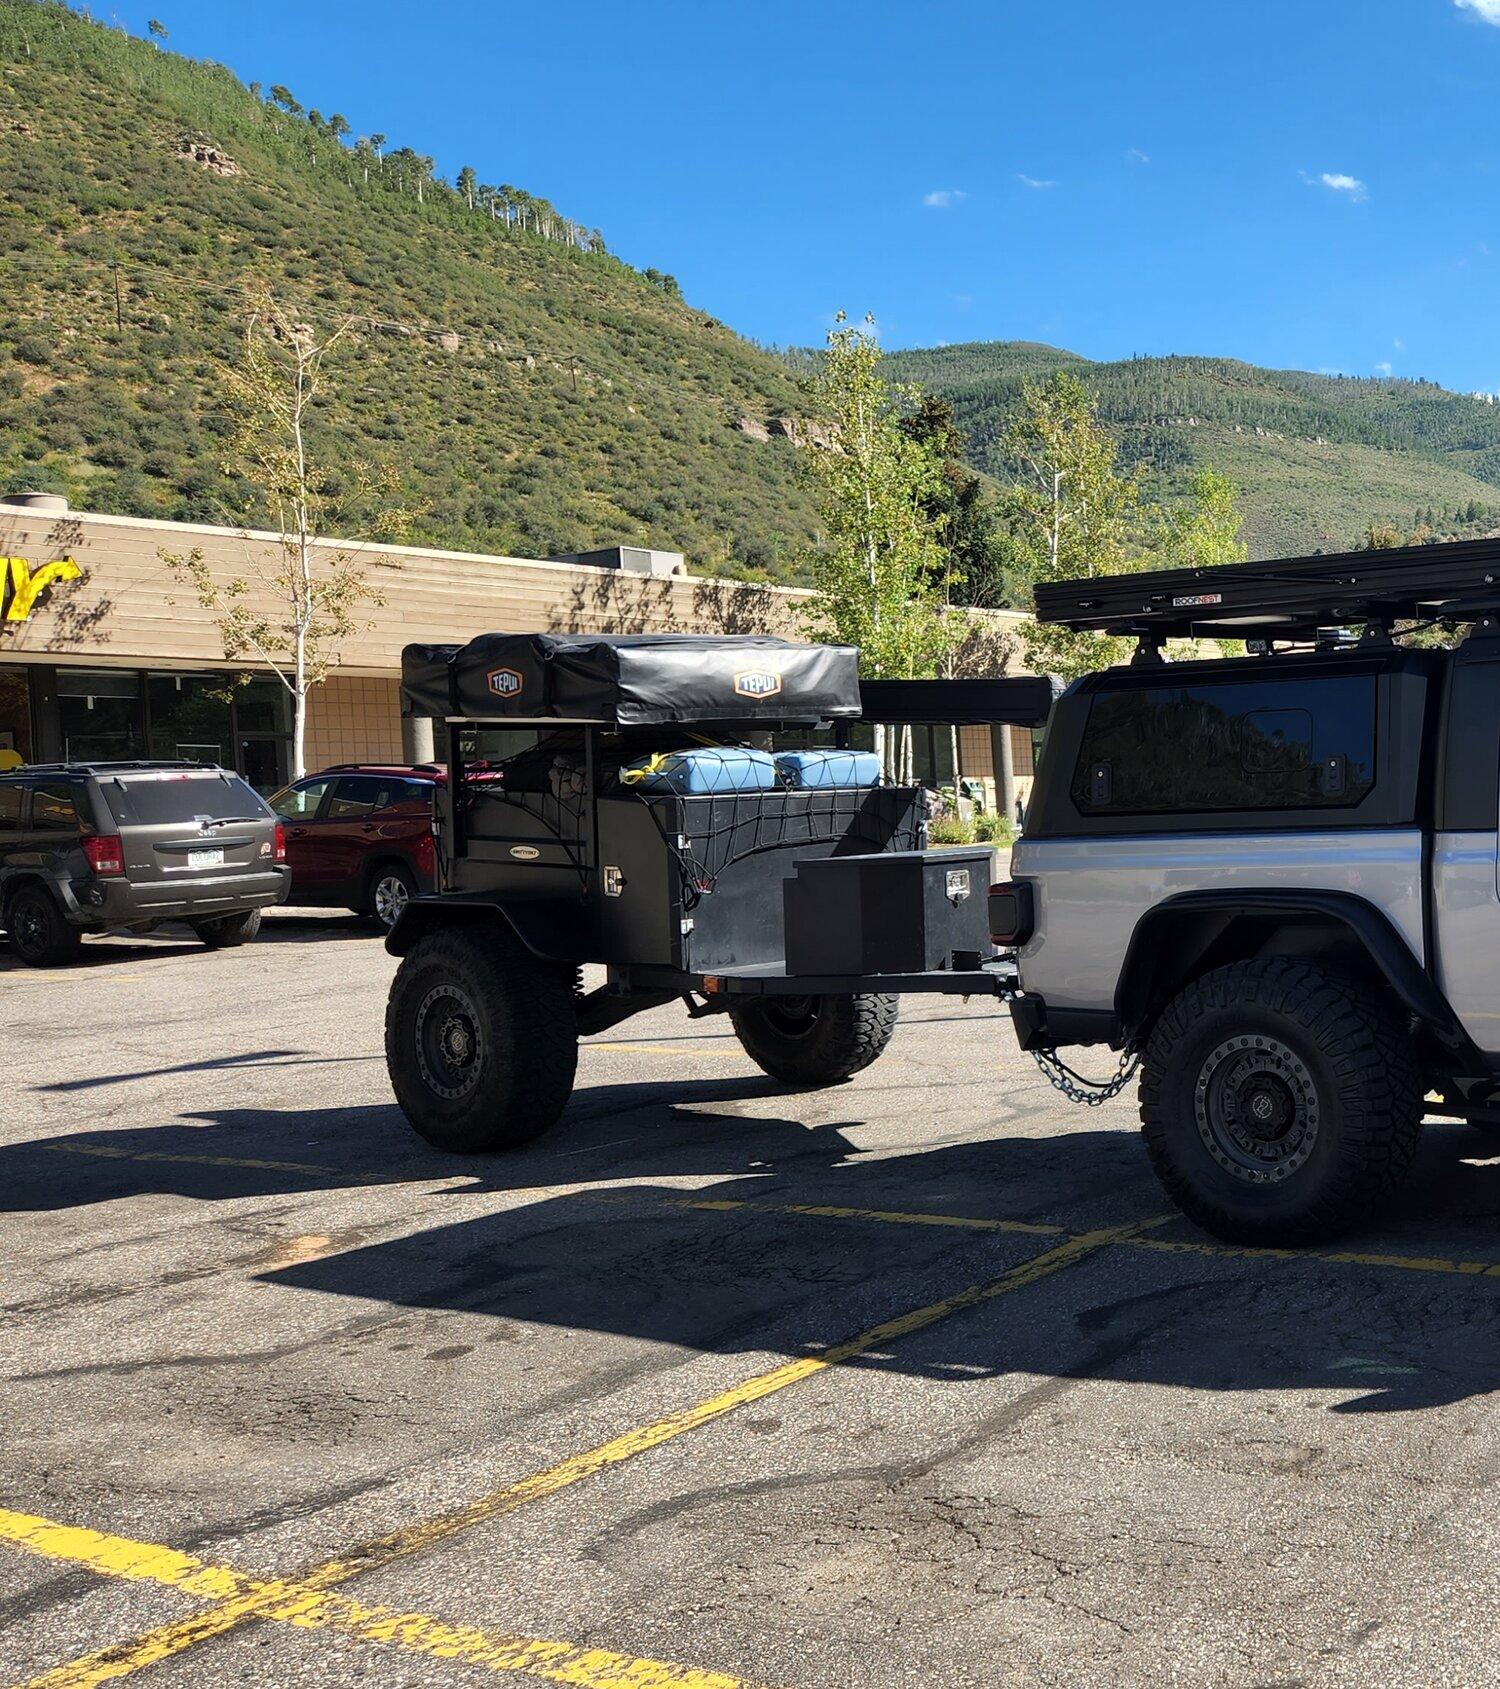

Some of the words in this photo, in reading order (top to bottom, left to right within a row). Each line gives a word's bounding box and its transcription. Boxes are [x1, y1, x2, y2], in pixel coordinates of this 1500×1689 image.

[1174, 594, 1219, 606] ROOFNEST
[492, 672, 518, 692] TEPUI
[740, 674, 775, 693] TEPUI
